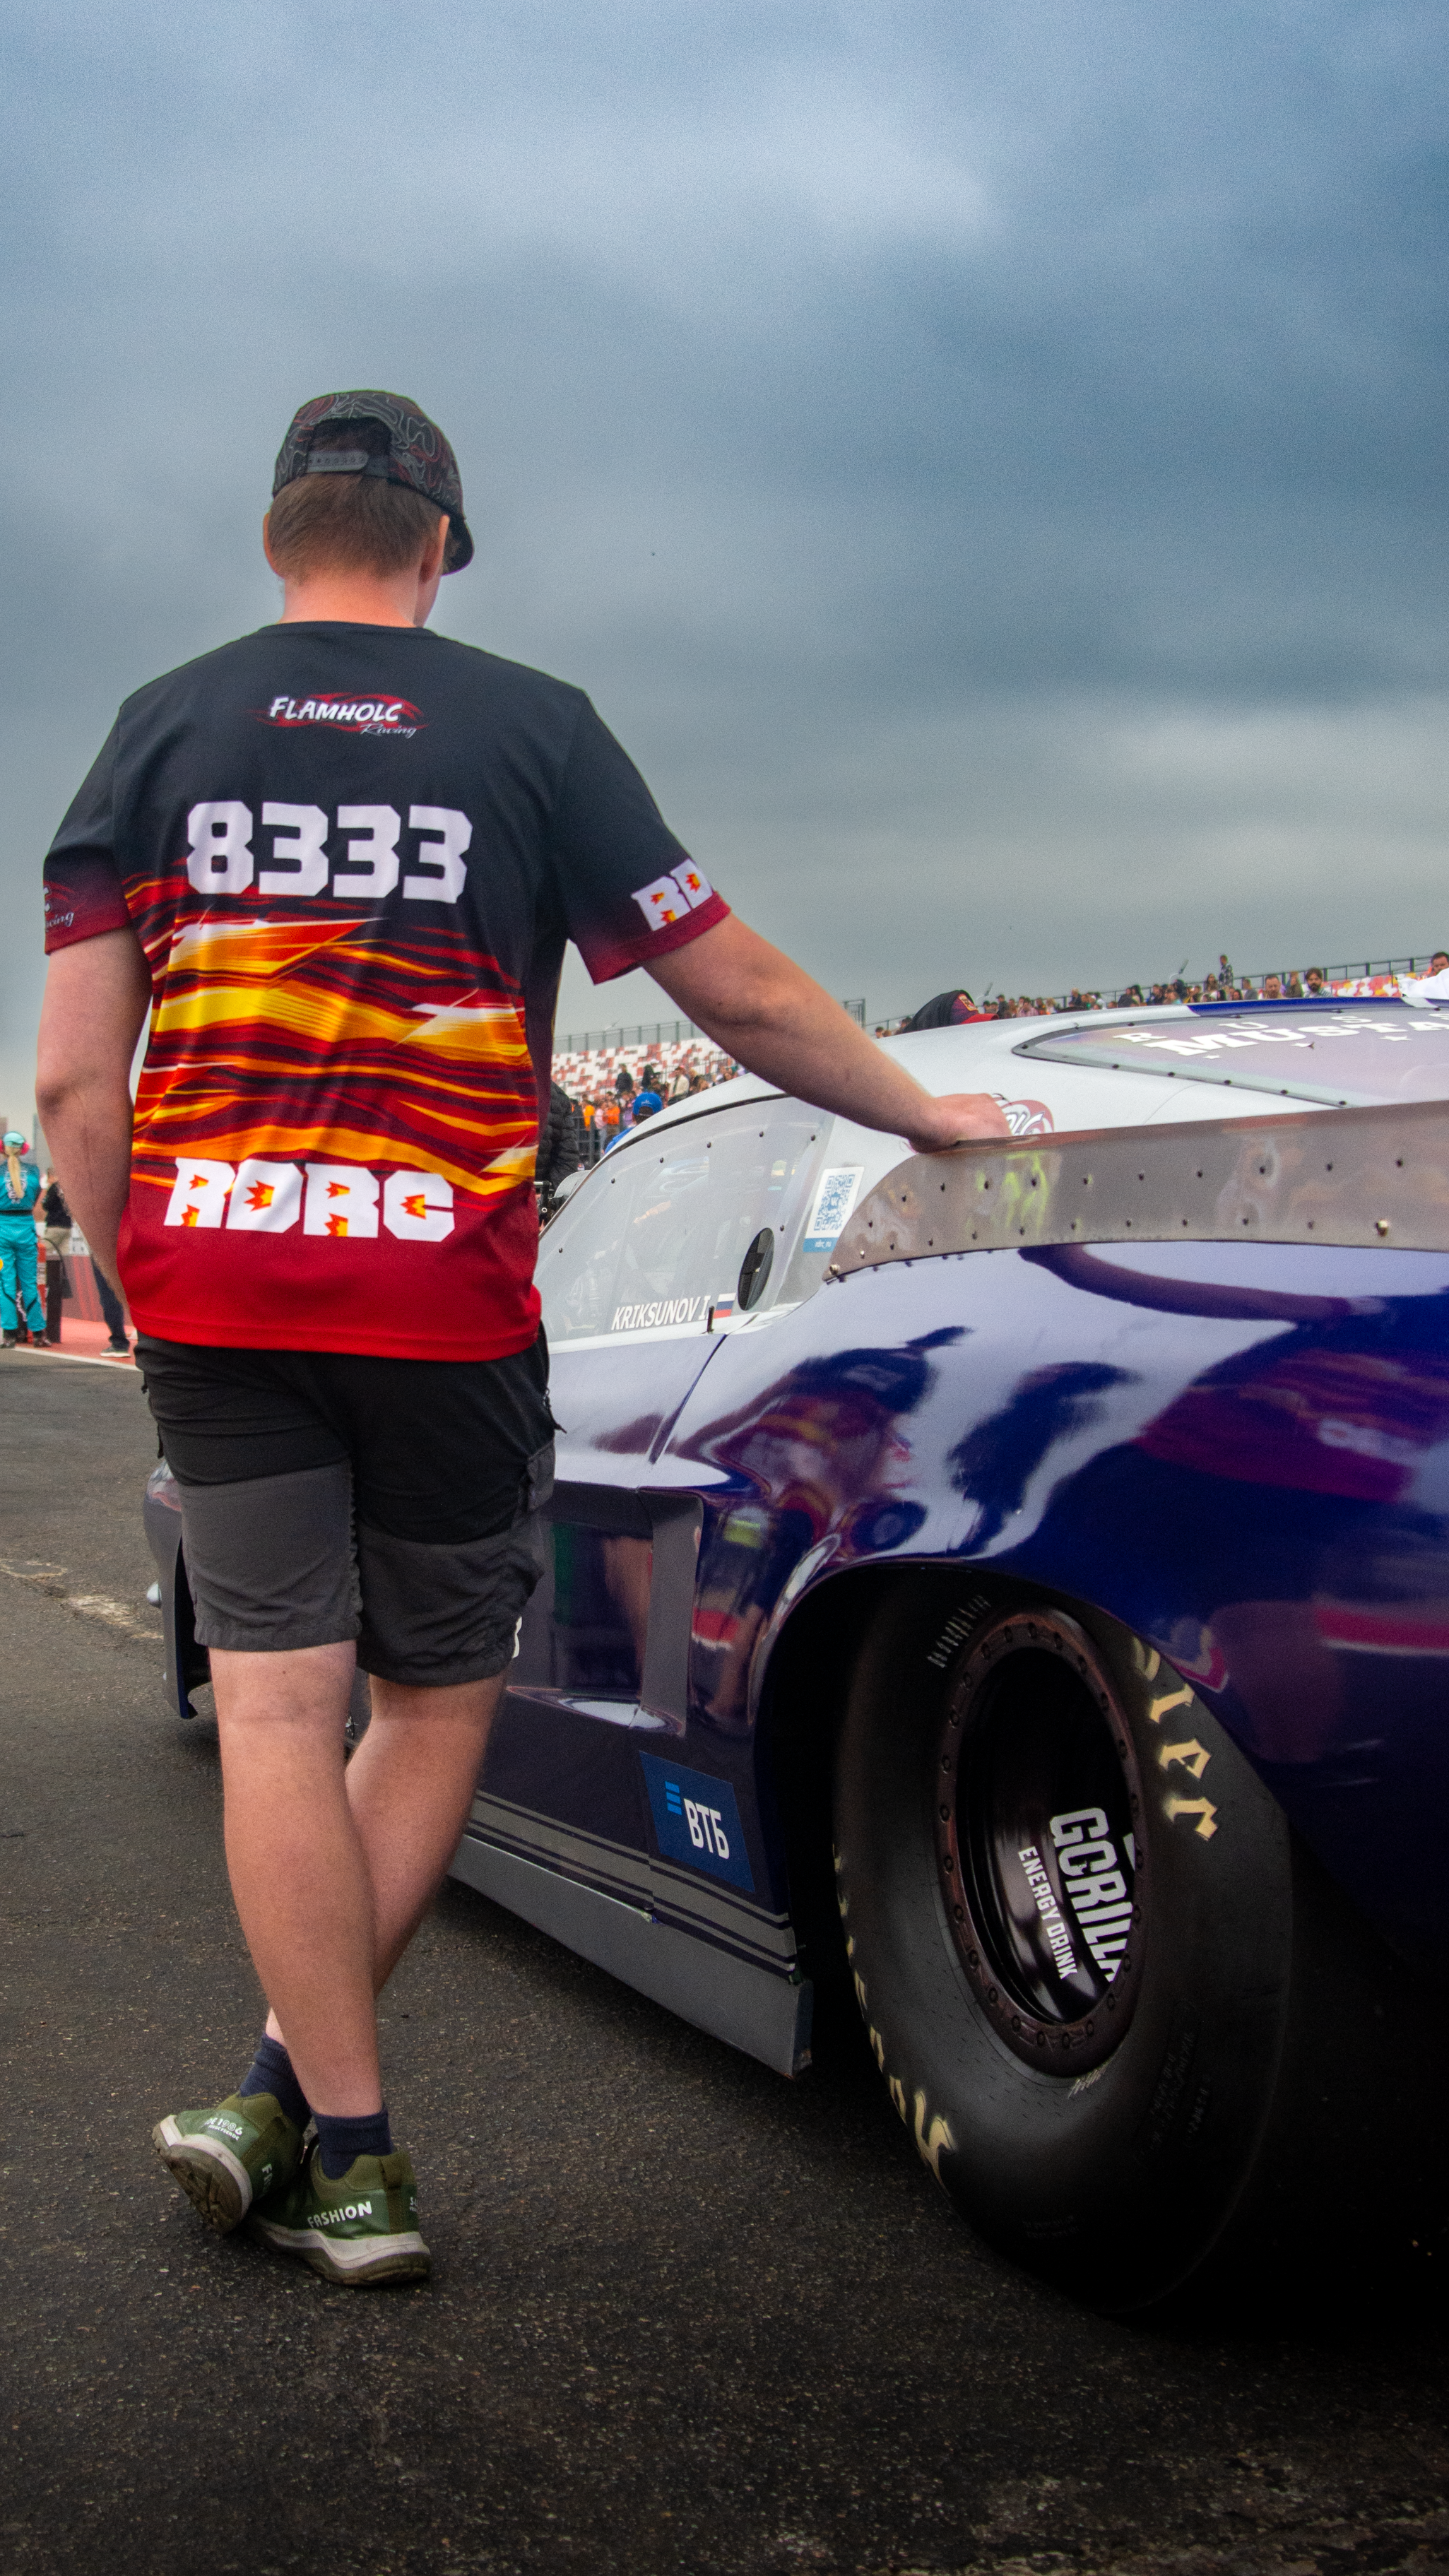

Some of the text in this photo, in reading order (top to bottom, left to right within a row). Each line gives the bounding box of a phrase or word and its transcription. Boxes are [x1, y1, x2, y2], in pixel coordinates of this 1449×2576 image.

[269, 696, 403, 722] FLAMHOLC
[360, 723, 417, 739] Racing
[187, 800, 473, 904] 8333
[163, 1157, 455, 1242] RDRC
[611, 1296, 701, 1330] KRIKSUNOV
[683, 1797, 730, 1860] ВТБ
[1018, 1845, 1078, 1980] ENERGY DRINK
[307, 2200, 373, 2228] FASHION
